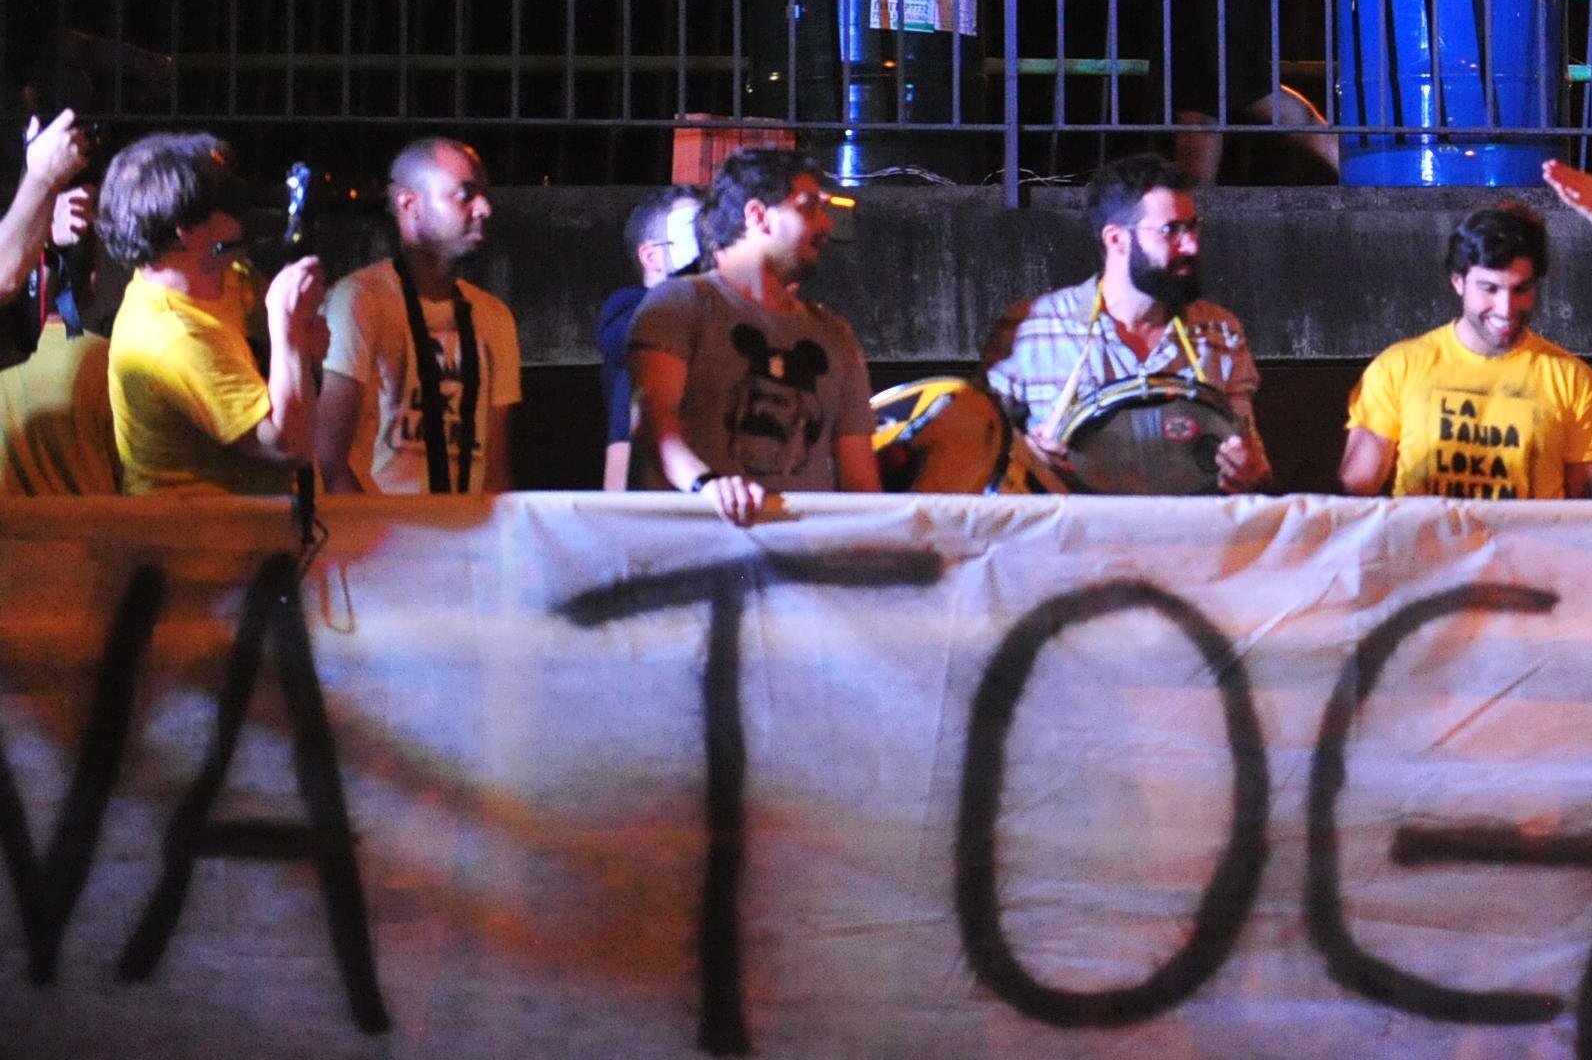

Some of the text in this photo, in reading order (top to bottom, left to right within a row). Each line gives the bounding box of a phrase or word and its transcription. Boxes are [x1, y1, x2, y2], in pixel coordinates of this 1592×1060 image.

[1441, 396, 1476, 419] LA
[1440, 417, 1519, 448] BANDA
[1436, 449, 1508, 479] LOKA
